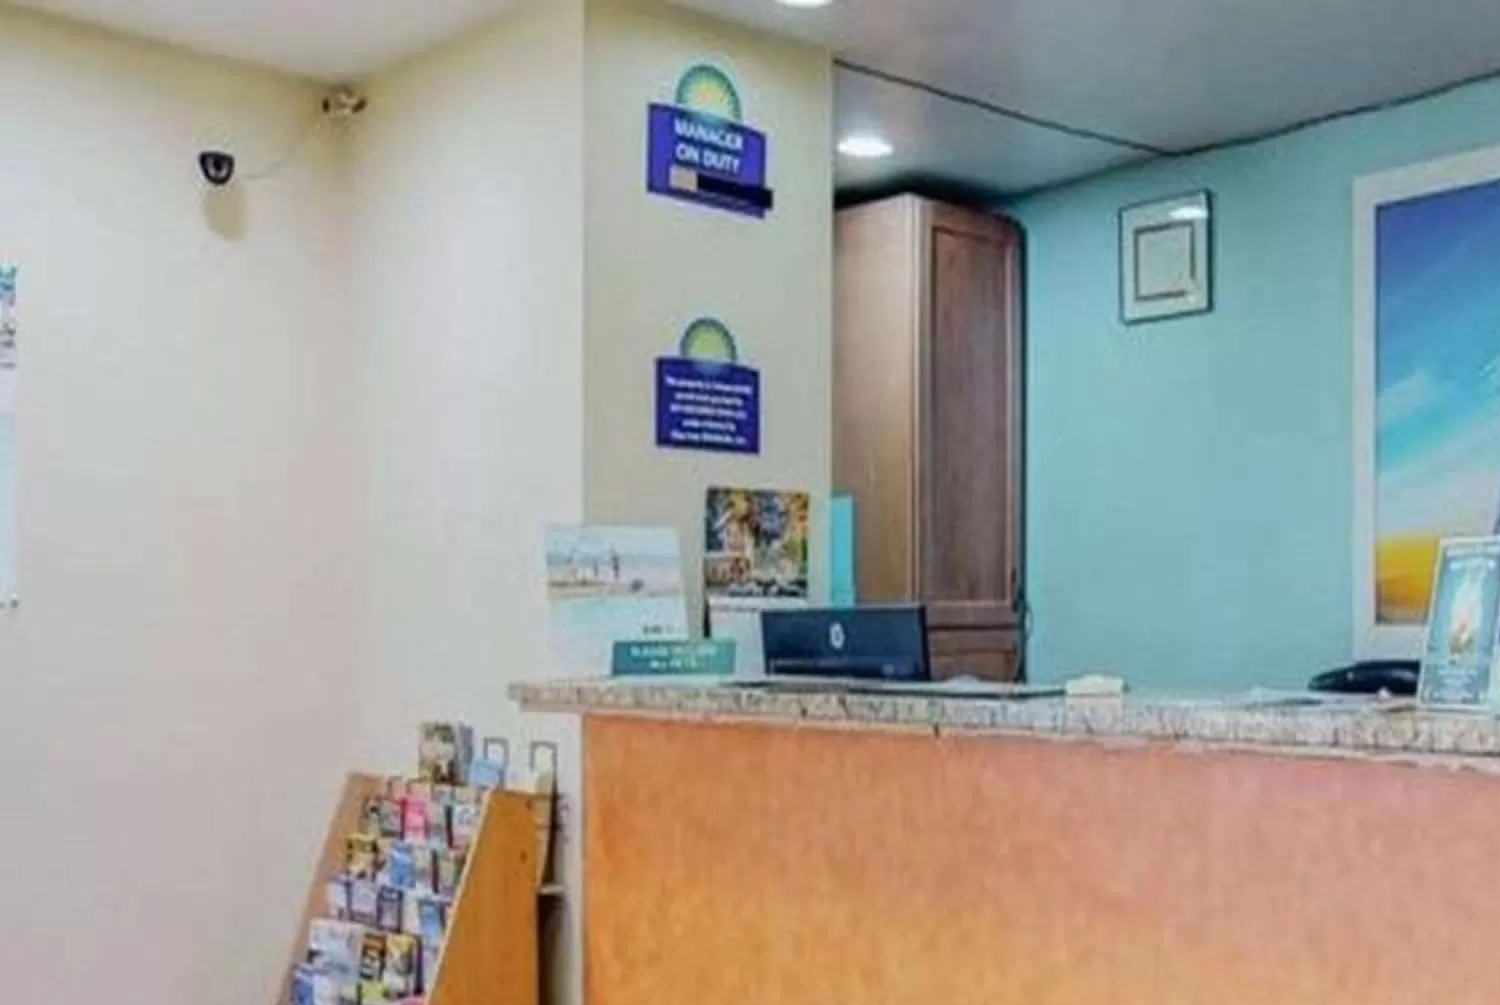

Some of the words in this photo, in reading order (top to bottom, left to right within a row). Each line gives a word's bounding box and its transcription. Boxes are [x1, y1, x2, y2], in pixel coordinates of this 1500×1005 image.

[674, 118, 744, 151] MANAGER
[676, 143, 699, 163] ON
[703, 150, 740, 175] DUTY
